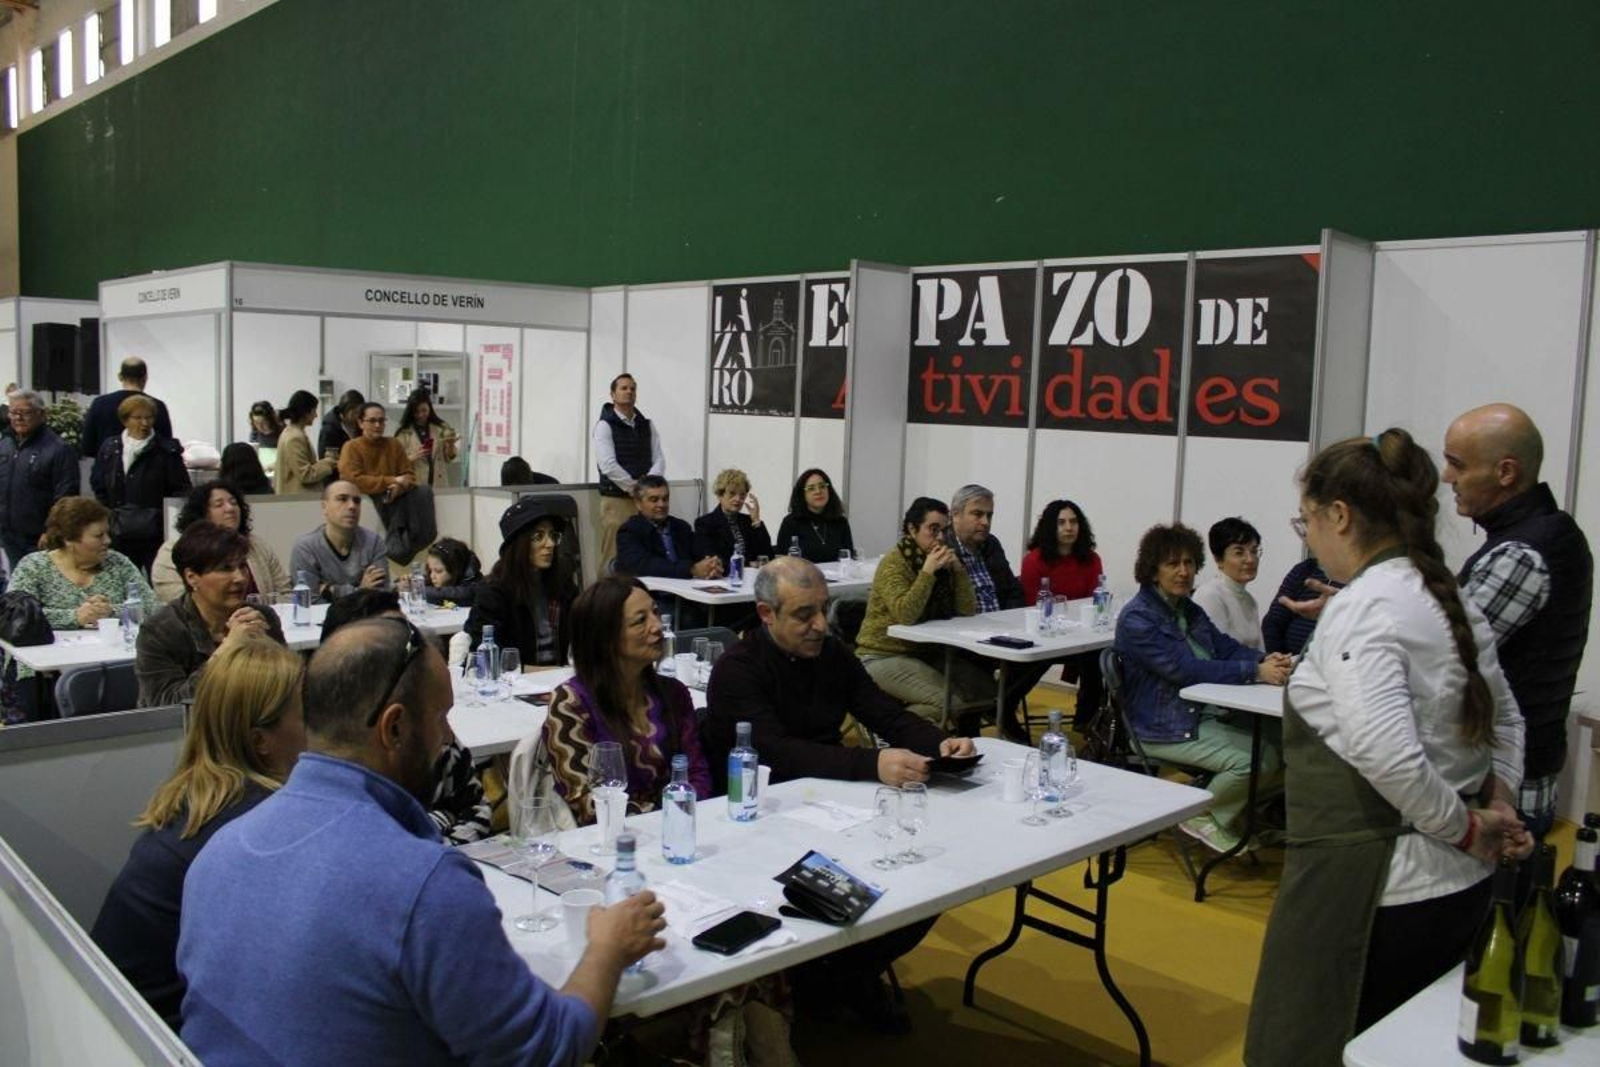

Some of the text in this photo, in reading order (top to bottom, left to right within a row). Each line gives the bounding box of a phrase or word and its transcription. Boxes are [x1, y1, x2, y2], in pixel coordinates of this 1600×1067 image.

[365, 288, 485, 309] CONCELLO DE VERÍN
[809, 283, 849, 347] E
[1197, 297, 1269, 345] DE
